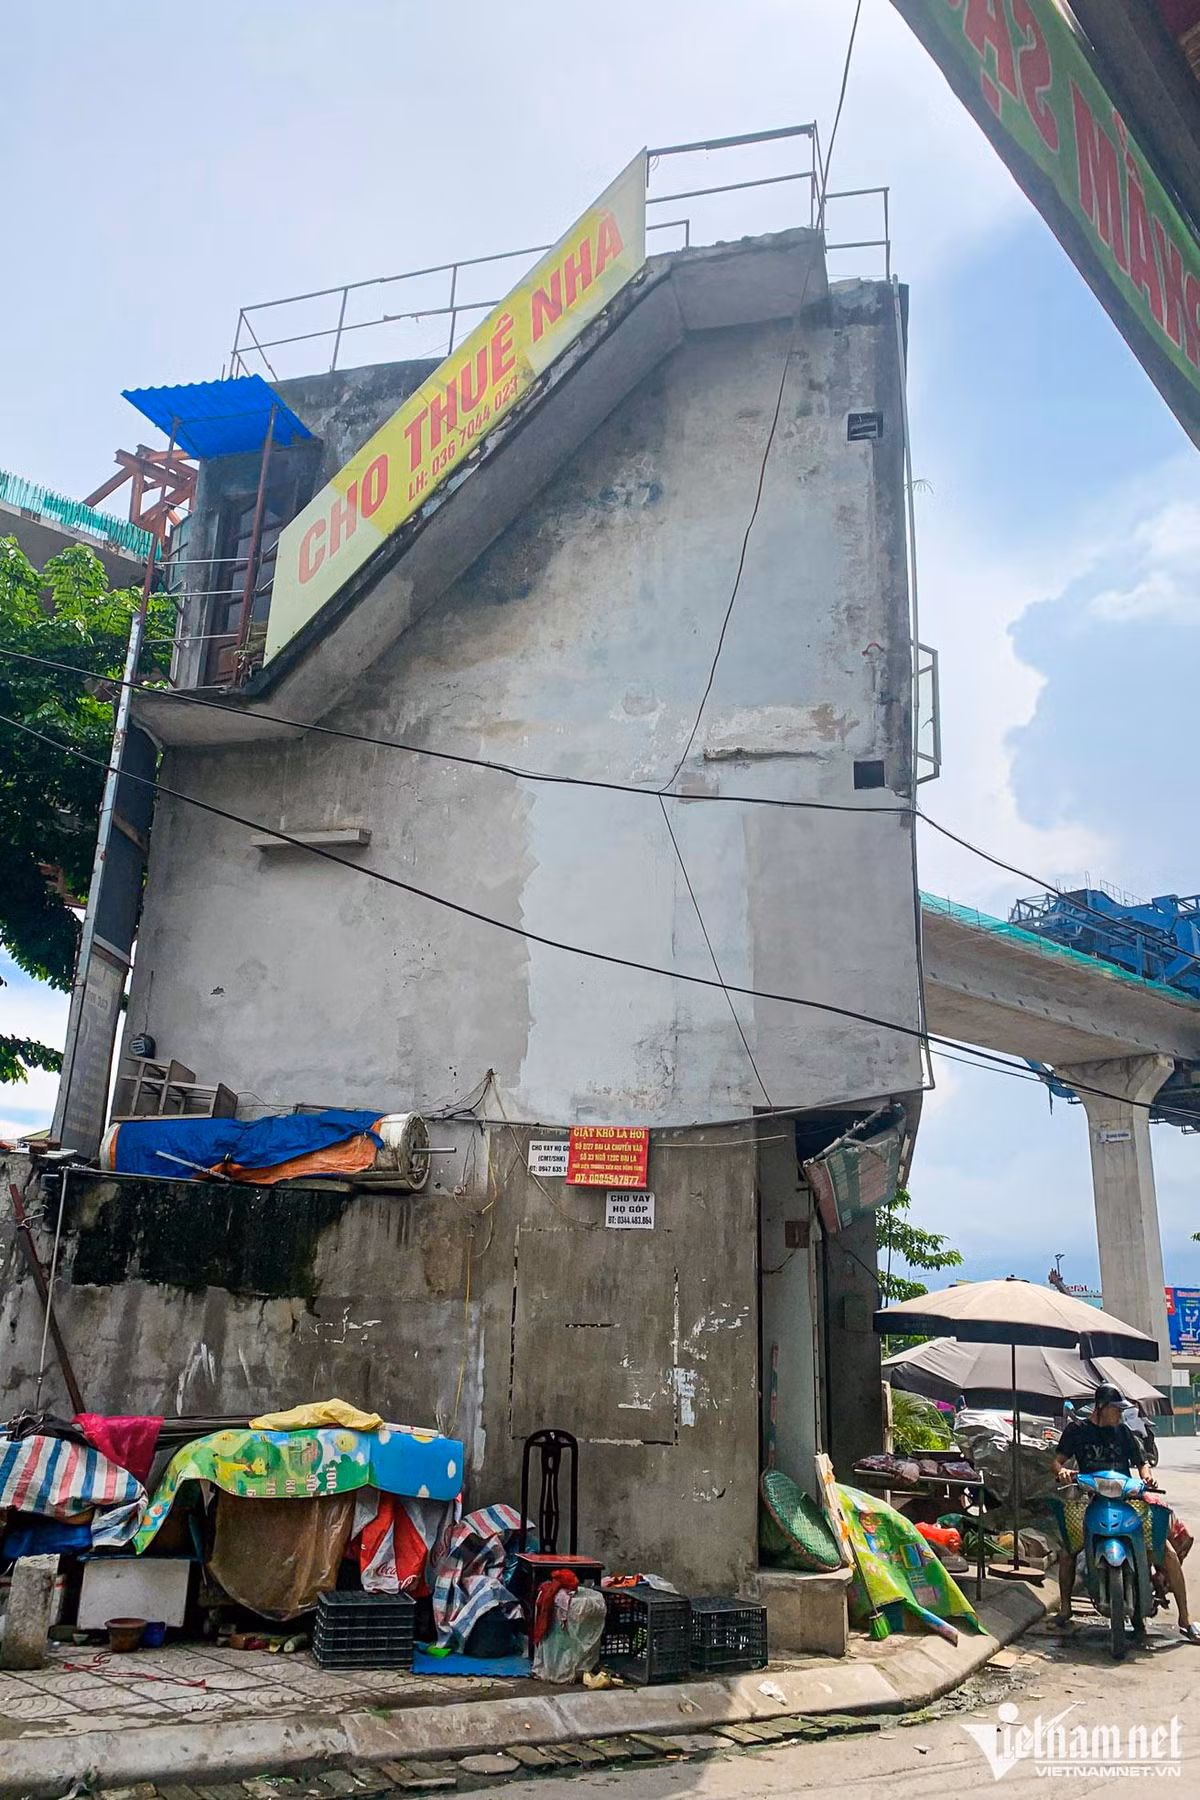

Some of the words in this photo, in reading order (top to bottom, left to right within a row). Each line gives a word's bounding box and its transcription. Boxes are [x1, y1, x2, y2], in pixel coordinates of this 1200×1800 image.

[299, 453, 389, 585] CHO
[403, 310, 517, 472] THUÊ
[531, 208, 625, 344] NHÀ
[408, 469, 428, 502] LH:
[432, 439, 456, 476] 036
[596, 1127, 614, 1138] KHÔ
[628, 1204, 648, 1212] GÓP
[326, 1468, 336, 1489] 100
